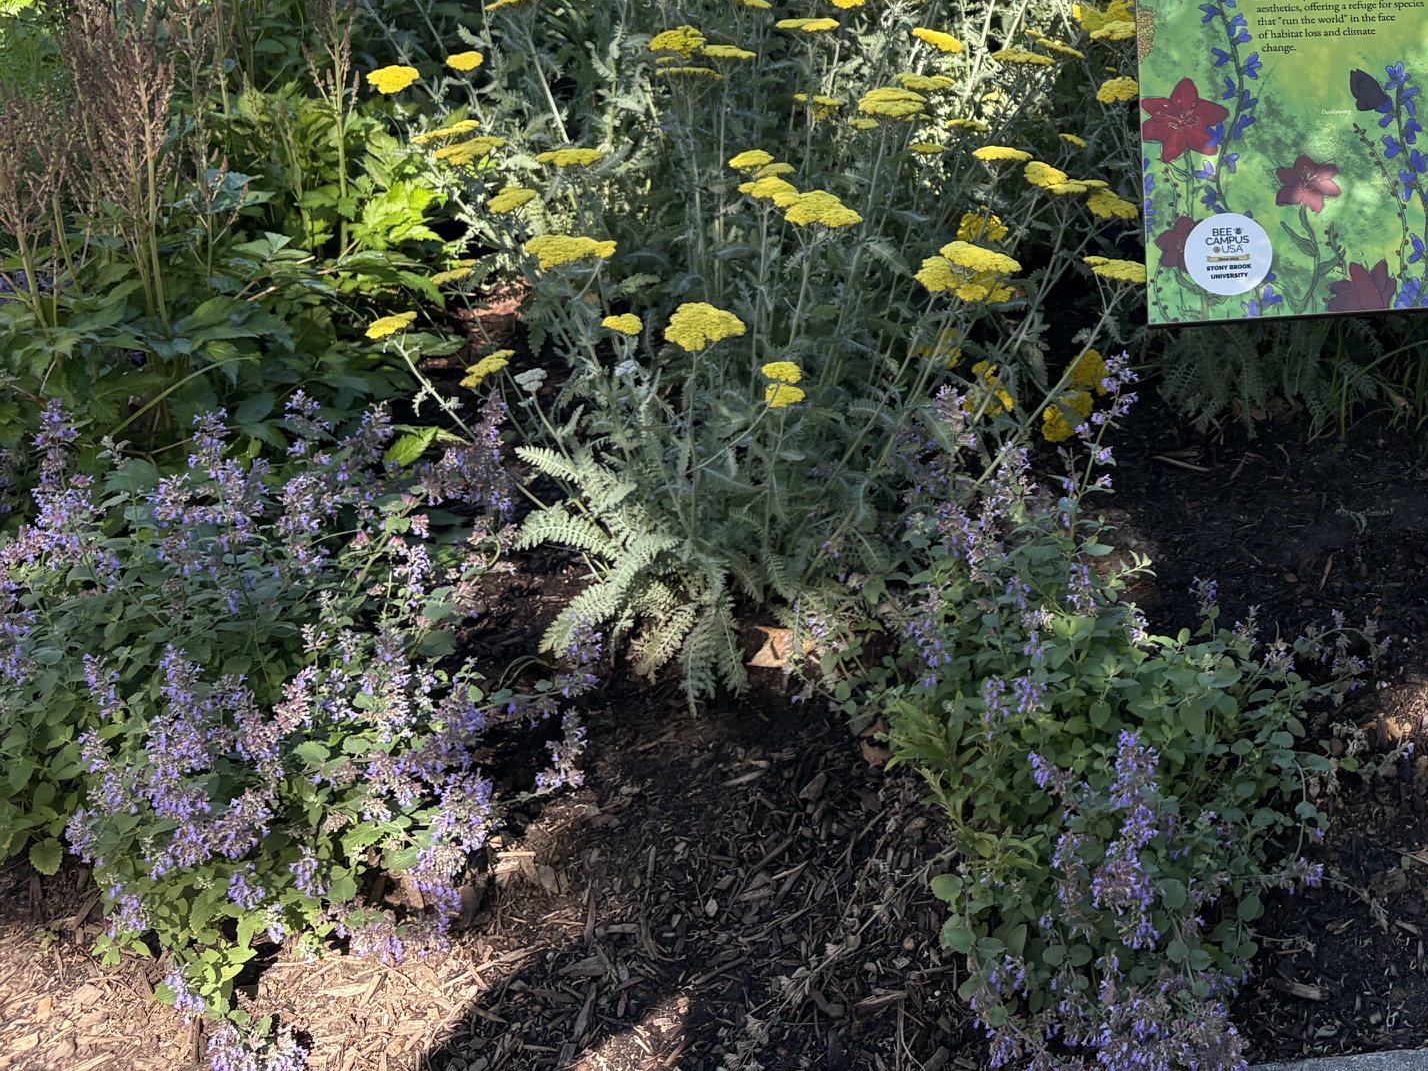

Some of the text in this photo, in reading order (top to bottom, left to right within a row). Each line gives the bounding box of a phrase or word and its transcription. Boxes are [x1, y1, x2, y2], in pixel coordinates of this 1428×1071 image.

[1256, 2, 1302, 14] aesthetics,
[1303, 1, 1340, 13] offering
[1348, 0, 1377, 12] refuge
[1378, 0, 1391, 8] for
[1393, 0, 1424, 10] species
[1257, 12, 1395, 26] that "run the world" in the face
[1258, 26, 1375, 39] of habitat loss and climate
[1261, 42, 1296, 54] change.
[1213, 228, 1232, 236] BEE
[1206, 235, 1249, 245] CAMPUS
[1222, 245, 1243, 253] USA
